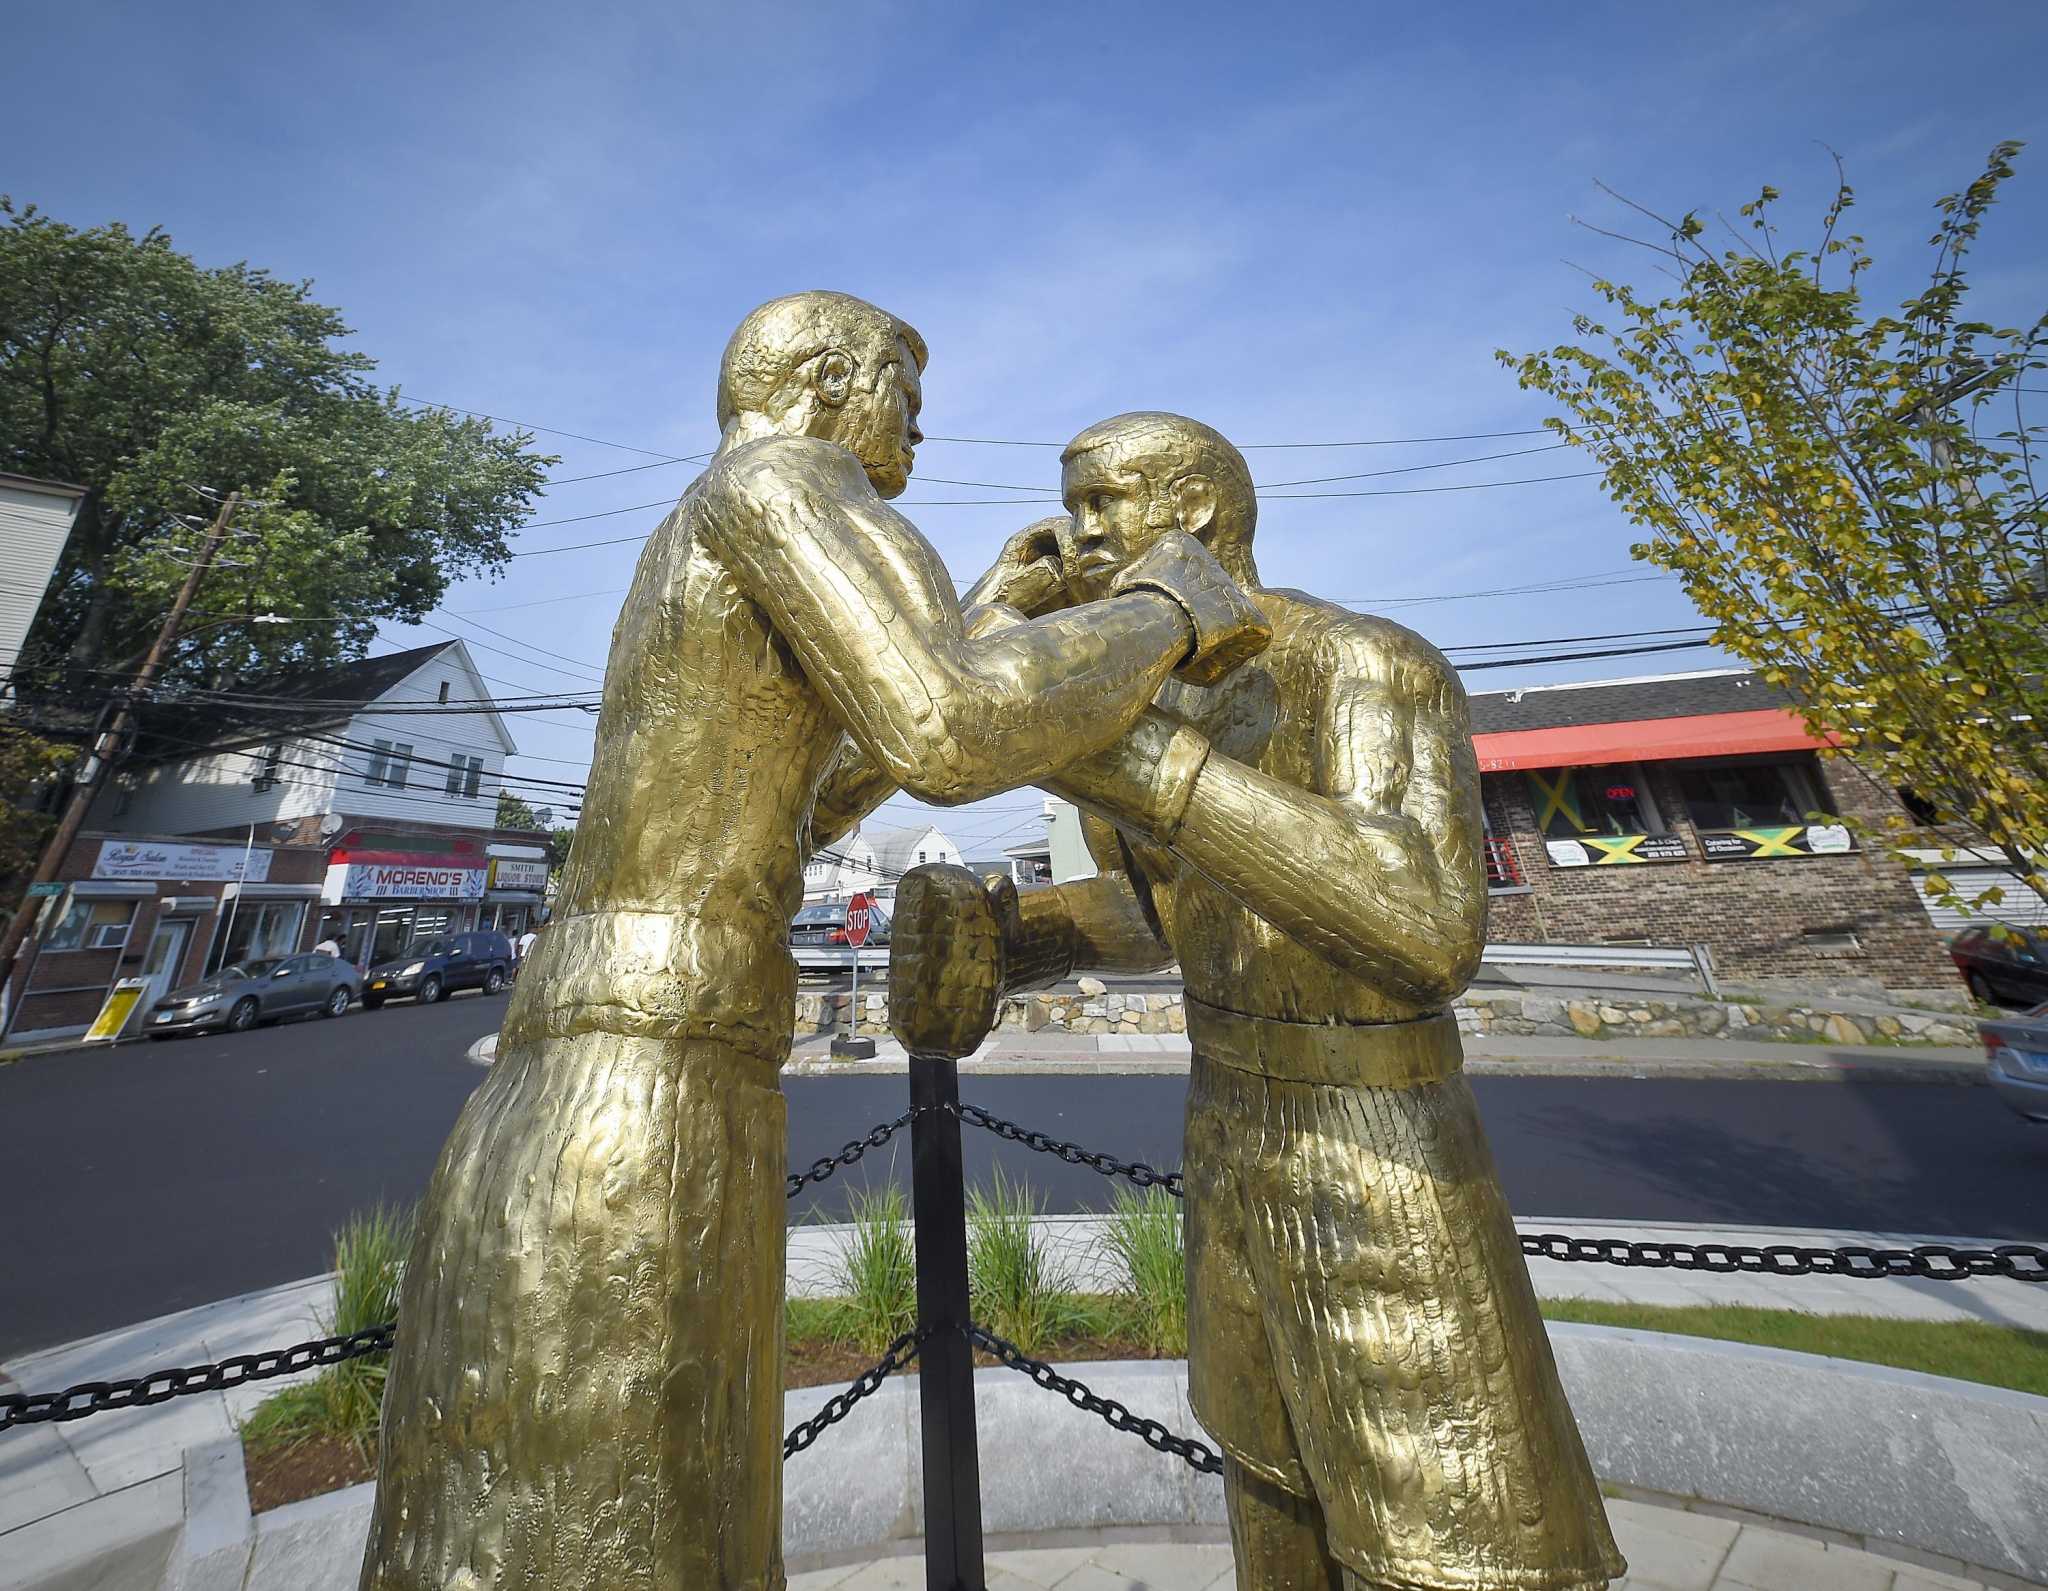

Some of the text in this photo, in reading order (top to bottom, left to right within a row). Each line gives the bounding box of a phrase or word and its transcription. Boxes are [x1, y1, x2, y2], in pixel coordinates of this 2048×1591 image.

[1605, 787, 1636, 799] OPEN
[511, 863, 534, 873] SMITH
[376, 869, 463, 886] MORENO'S
[847, 909, 869, 931] STOP
